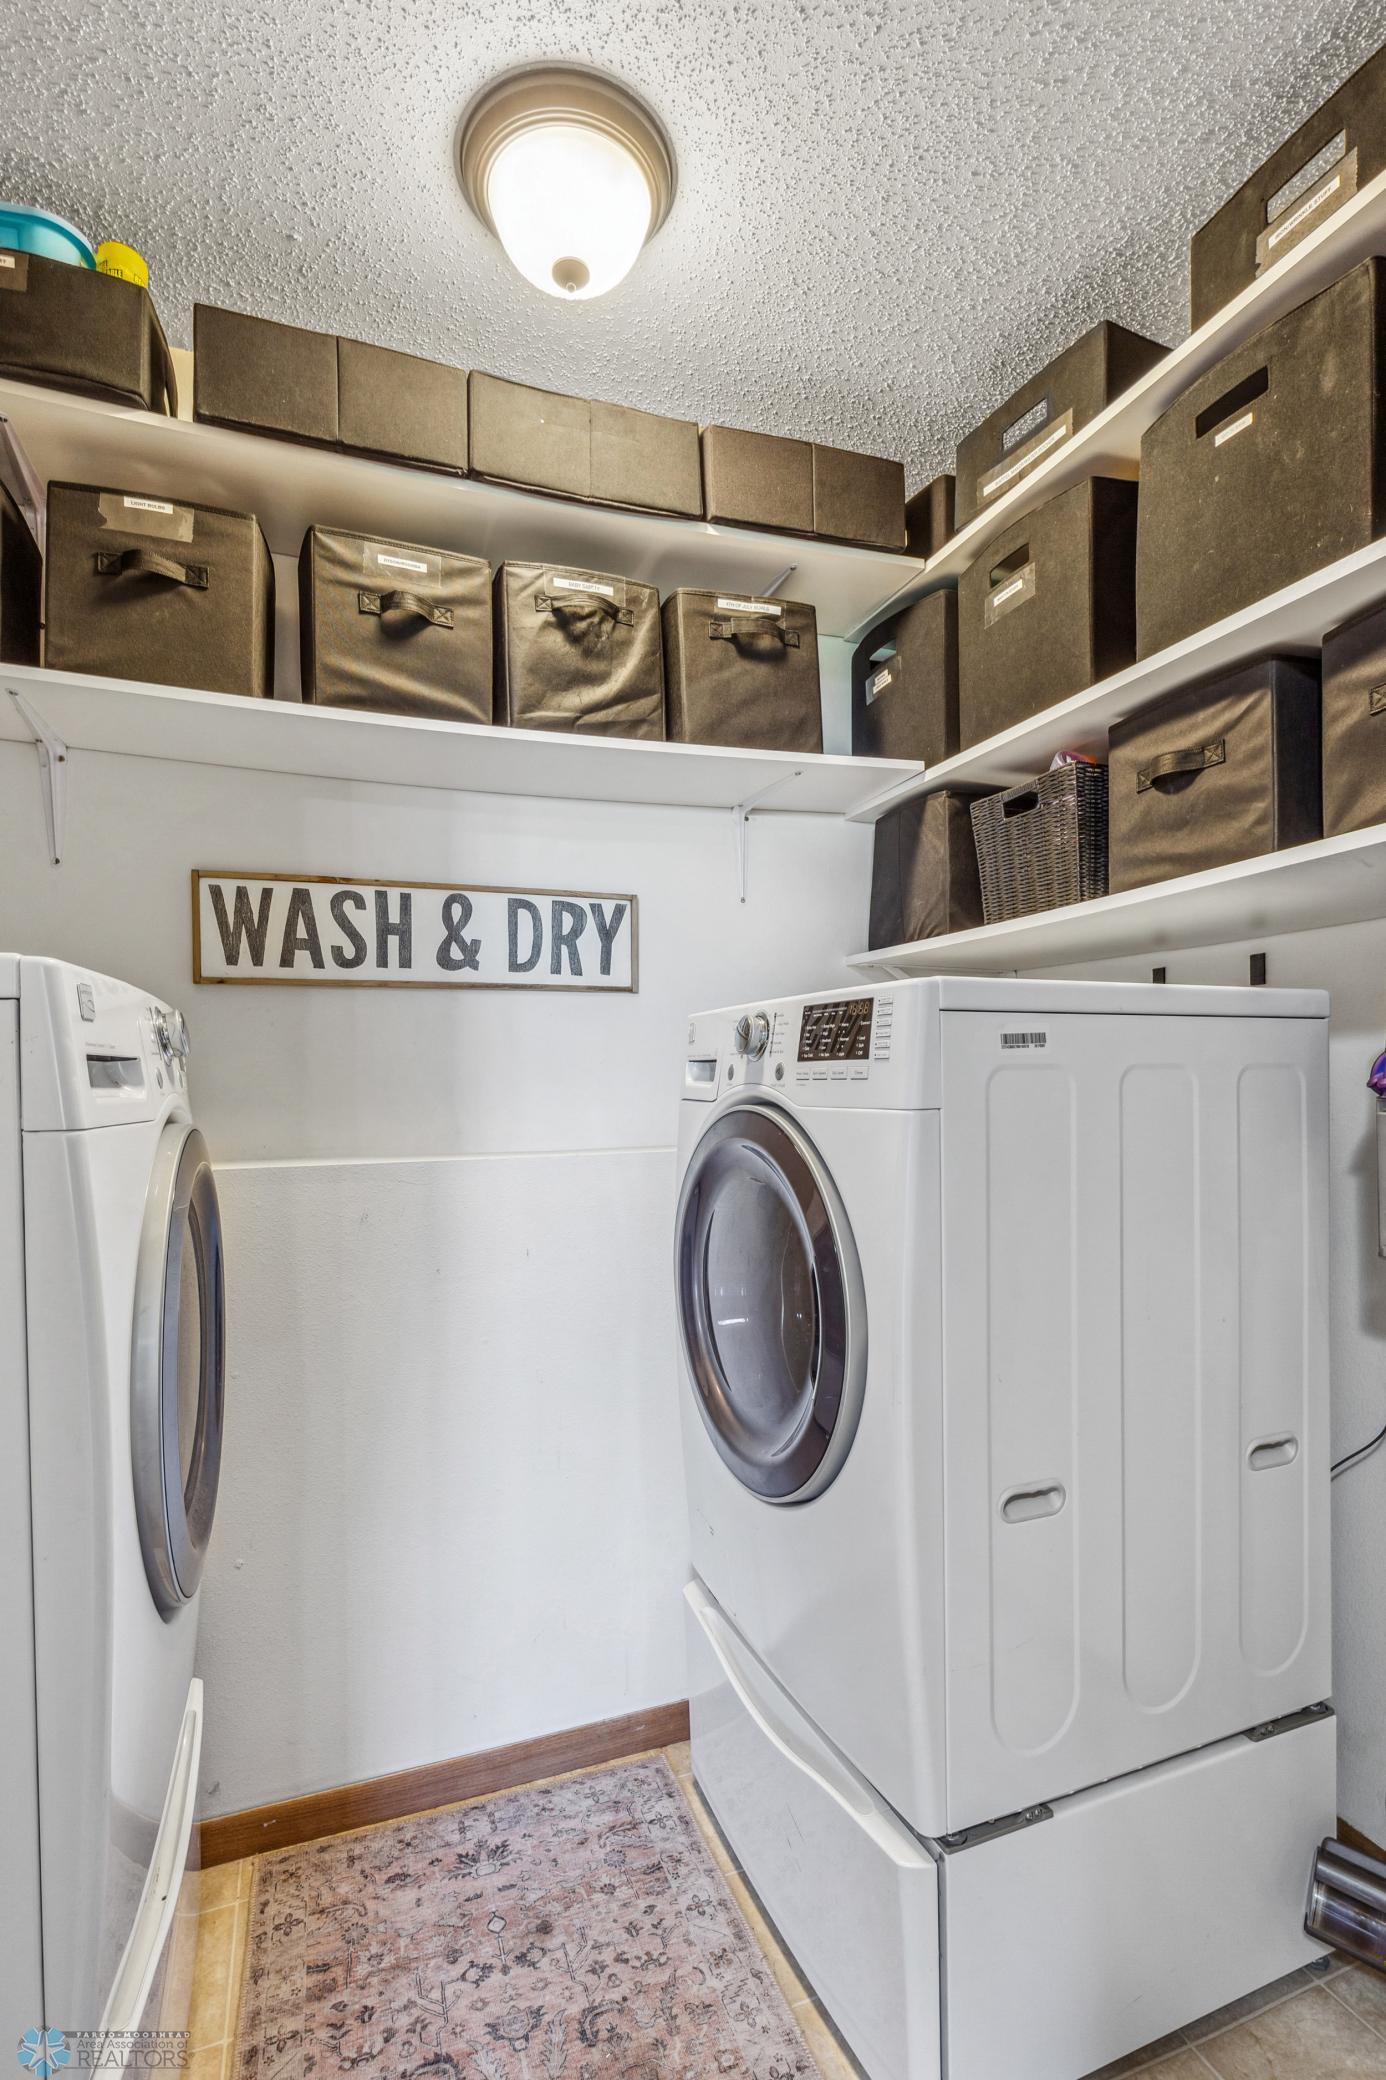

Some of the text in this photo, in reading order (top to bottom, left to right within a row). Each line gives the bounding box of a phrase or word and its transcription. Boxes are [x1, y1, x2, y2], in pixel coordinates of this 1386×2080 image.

[208, 884, 627, 976] WASH & DRY
